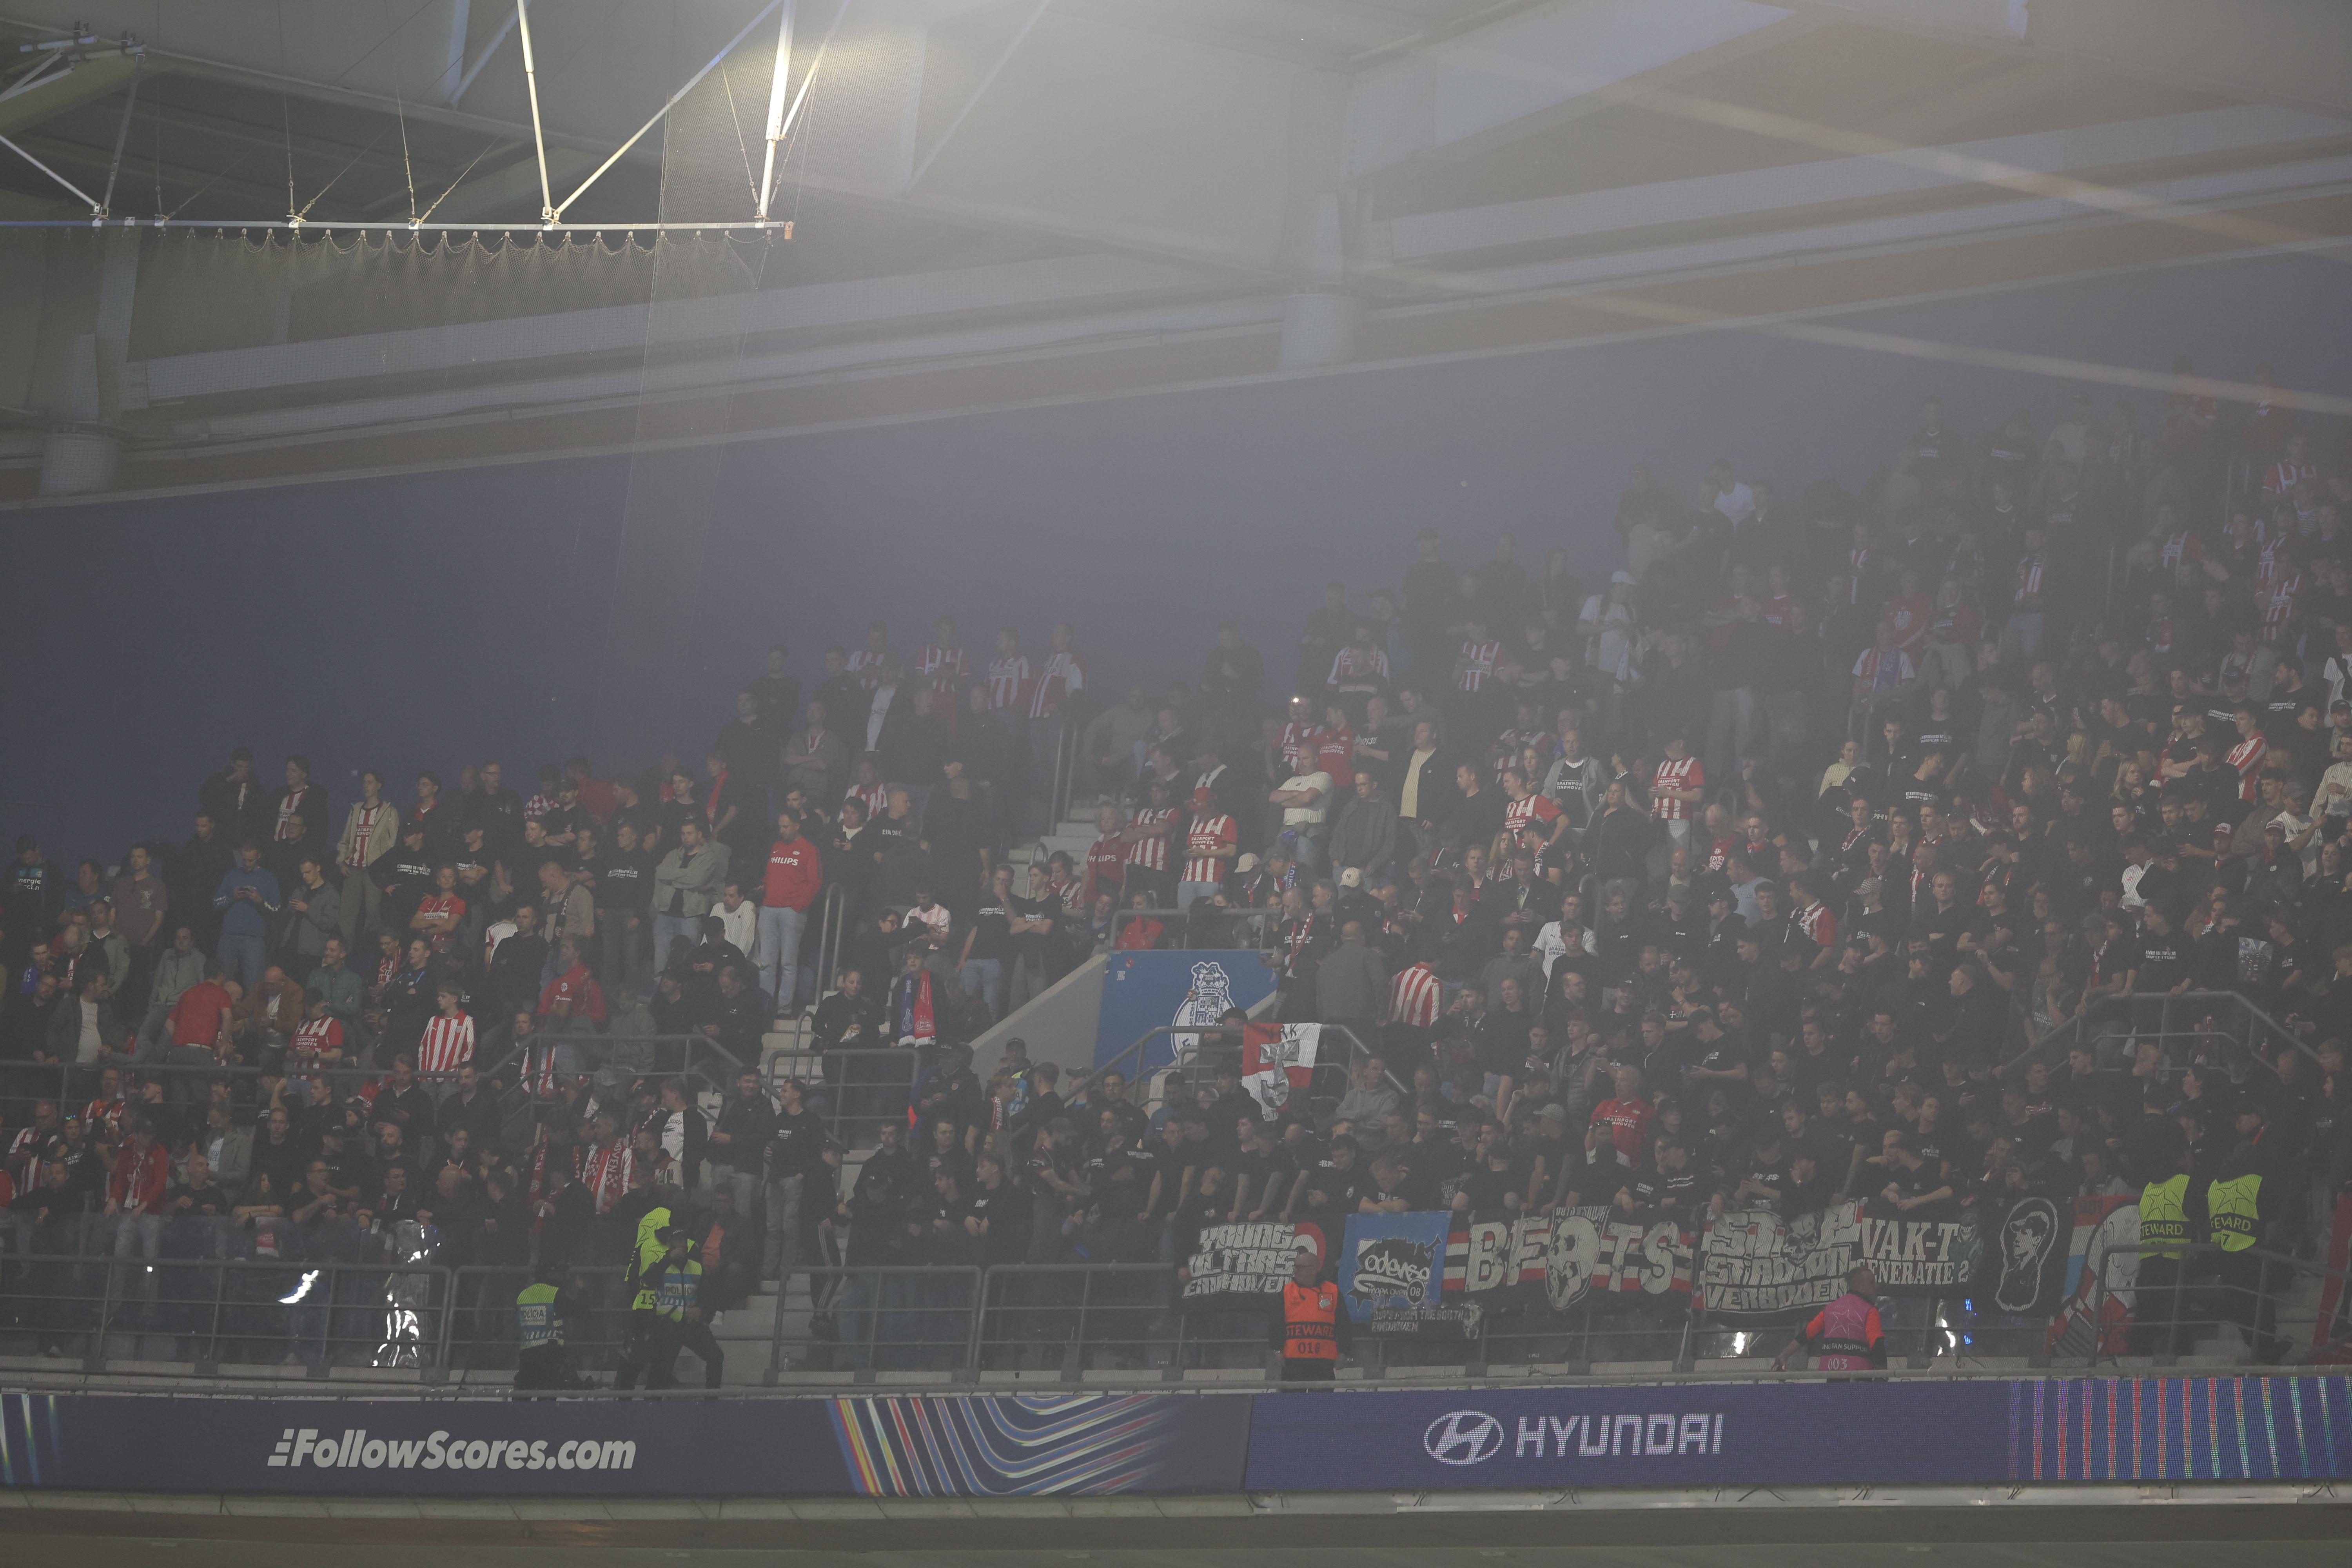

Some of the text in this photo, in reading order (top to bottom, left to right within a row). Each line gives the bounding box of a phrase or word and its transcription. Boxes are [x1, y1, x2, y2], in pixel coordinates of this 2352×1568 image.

[771, 857, 799, 866] HILIPS
[1861, 1217, 1960, 1261] VAK-T
[2141, 1223, 2183, 1236] TEWARD
[1958, 1259, 1969, 1283] 2
[290, 1428, 636, 1470] FollowScores.com
[1516, 1413, 1724, 1457] HYUNDAI
